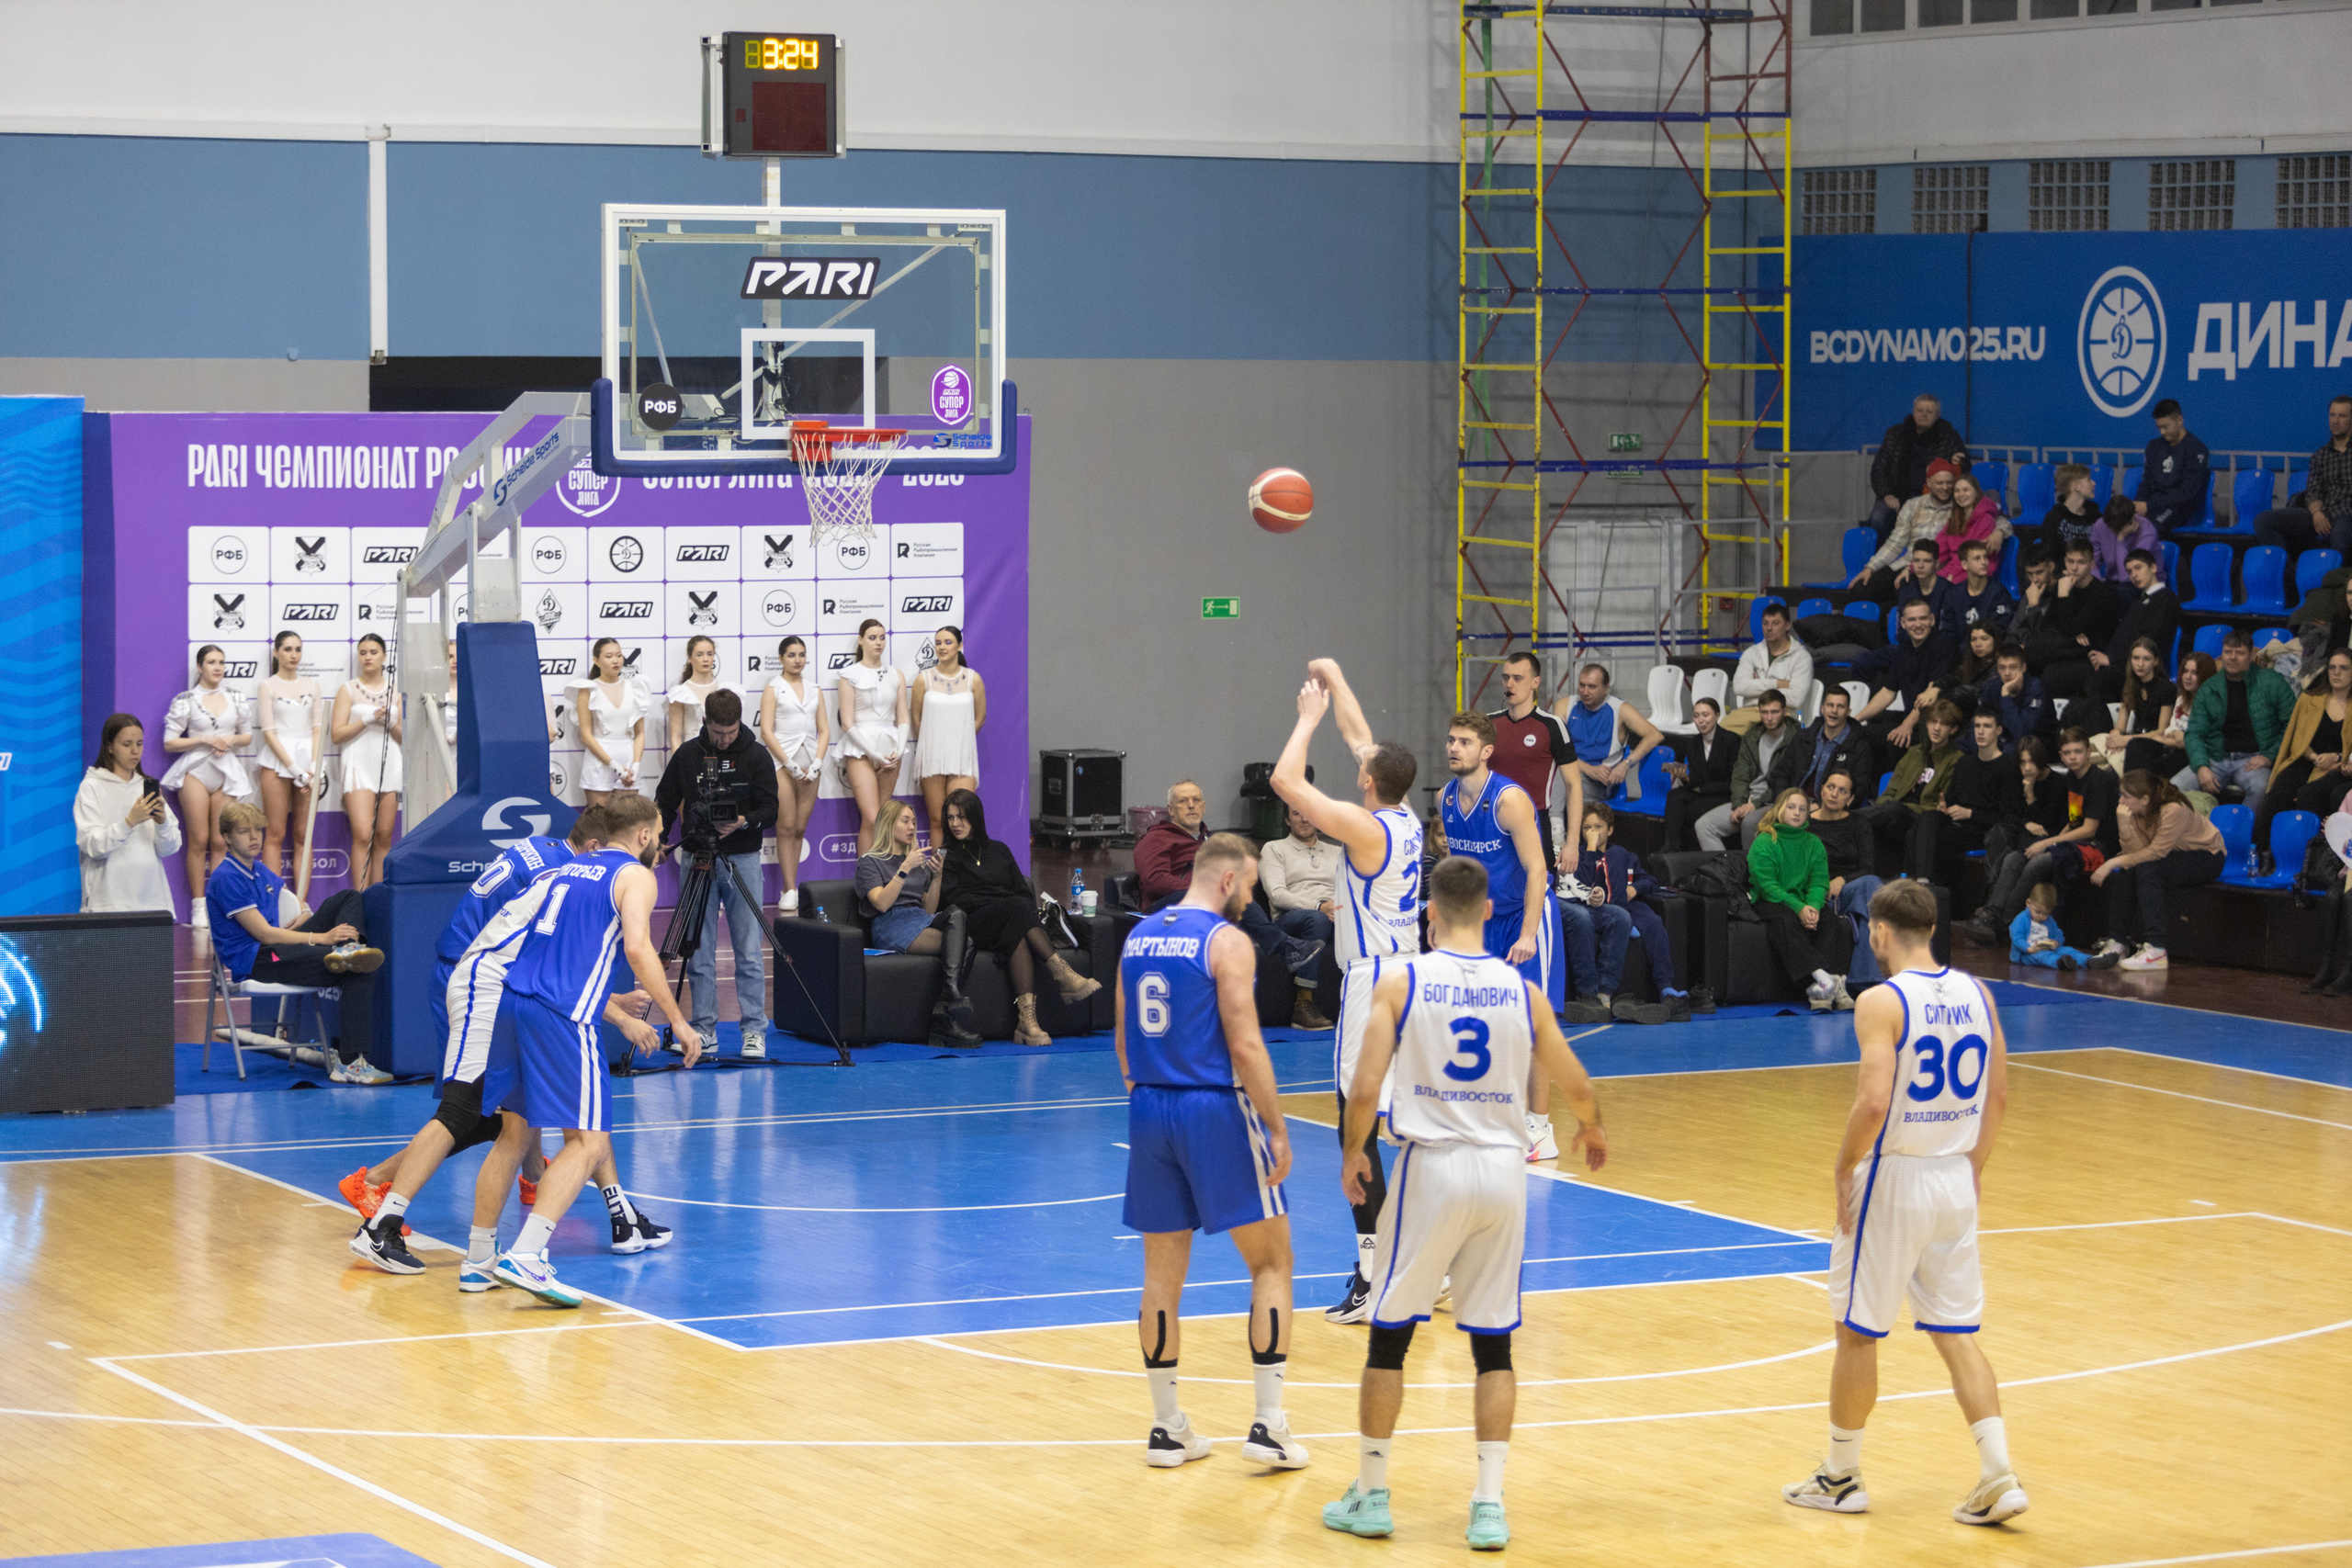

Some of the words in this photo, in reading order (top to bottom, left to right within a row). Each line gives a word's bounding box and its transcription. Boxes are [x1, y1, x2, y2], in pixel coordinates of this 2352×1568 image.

[745, 261, 875, 296] PARI
[1810, 325, 2046, 364] BCDYNAMO25.RU
[645, 400, 677, 413] РФБ
[953, 433, 992, 441] Schelde
[187, 444, 248, 488] PARI
[506, 456, 535, 487] Schelde
[536, 433, 559, 459] Sports
[216, 549, 243, 560] РФБ
[536, 549, 562, 559] РФБ
[677, 546, 729, 561] PARI
[841, 547, 866, 557] РФБ
[283, 604, 338, 620] PARI
[600, 602, 653, 617] PARI
[766, 604, 791, 613] РФБ
[902, 596, 953, 613] PARI
[225, 661, 257, 678] ARI
[539, 659, 576, 674] ARI
[1124, 937, 1200, 958] МАРТЫНОВ
[1424, 983, 1518, 1008] БОГДАНОВИЧ
[1136, 972, 1170, 1037] 6
[1442, 1016, 1491, 1082] 3
[1905, 1033, 1988, 1102] 30
[1414, 1084, 1513, 1103] ВЛАДИВОСТОК
[1904, 1104, 1979, 1122] ВЛАДИВОСТОК
[602, 1186, 627, 1220] ELIT
